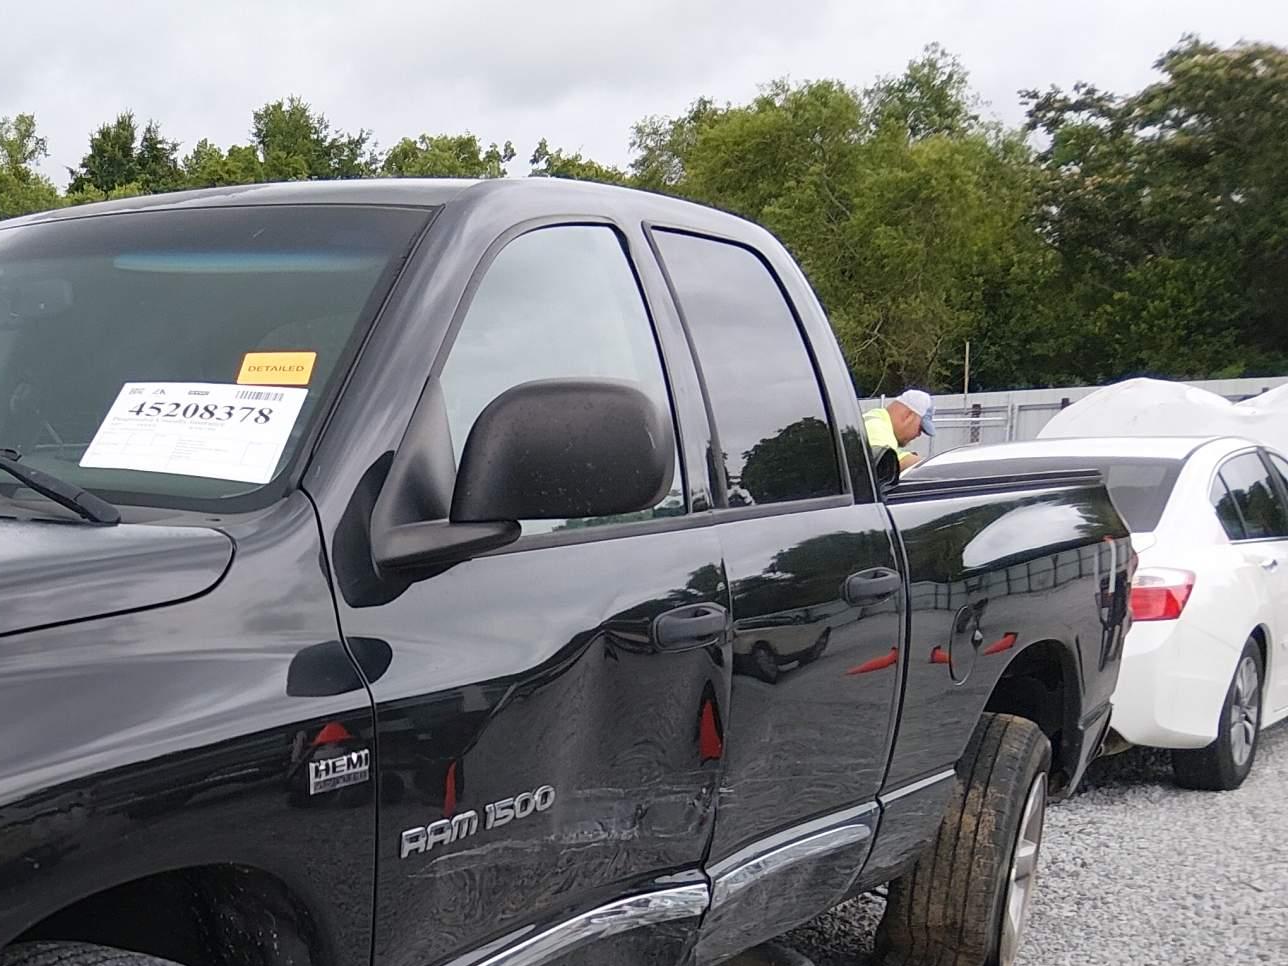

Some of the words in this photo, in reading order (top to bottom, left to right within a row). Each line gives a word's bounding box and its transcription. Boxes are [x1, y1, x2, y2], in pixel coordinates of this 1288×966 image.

[247, 364, 305, 373] DETAILED
[127, 401, 274, 425] 45208378
[314, 751, 370, 780] HEMI
[400, 810, 479, 859] RAM
[485, 784, 556, 830] 1500
